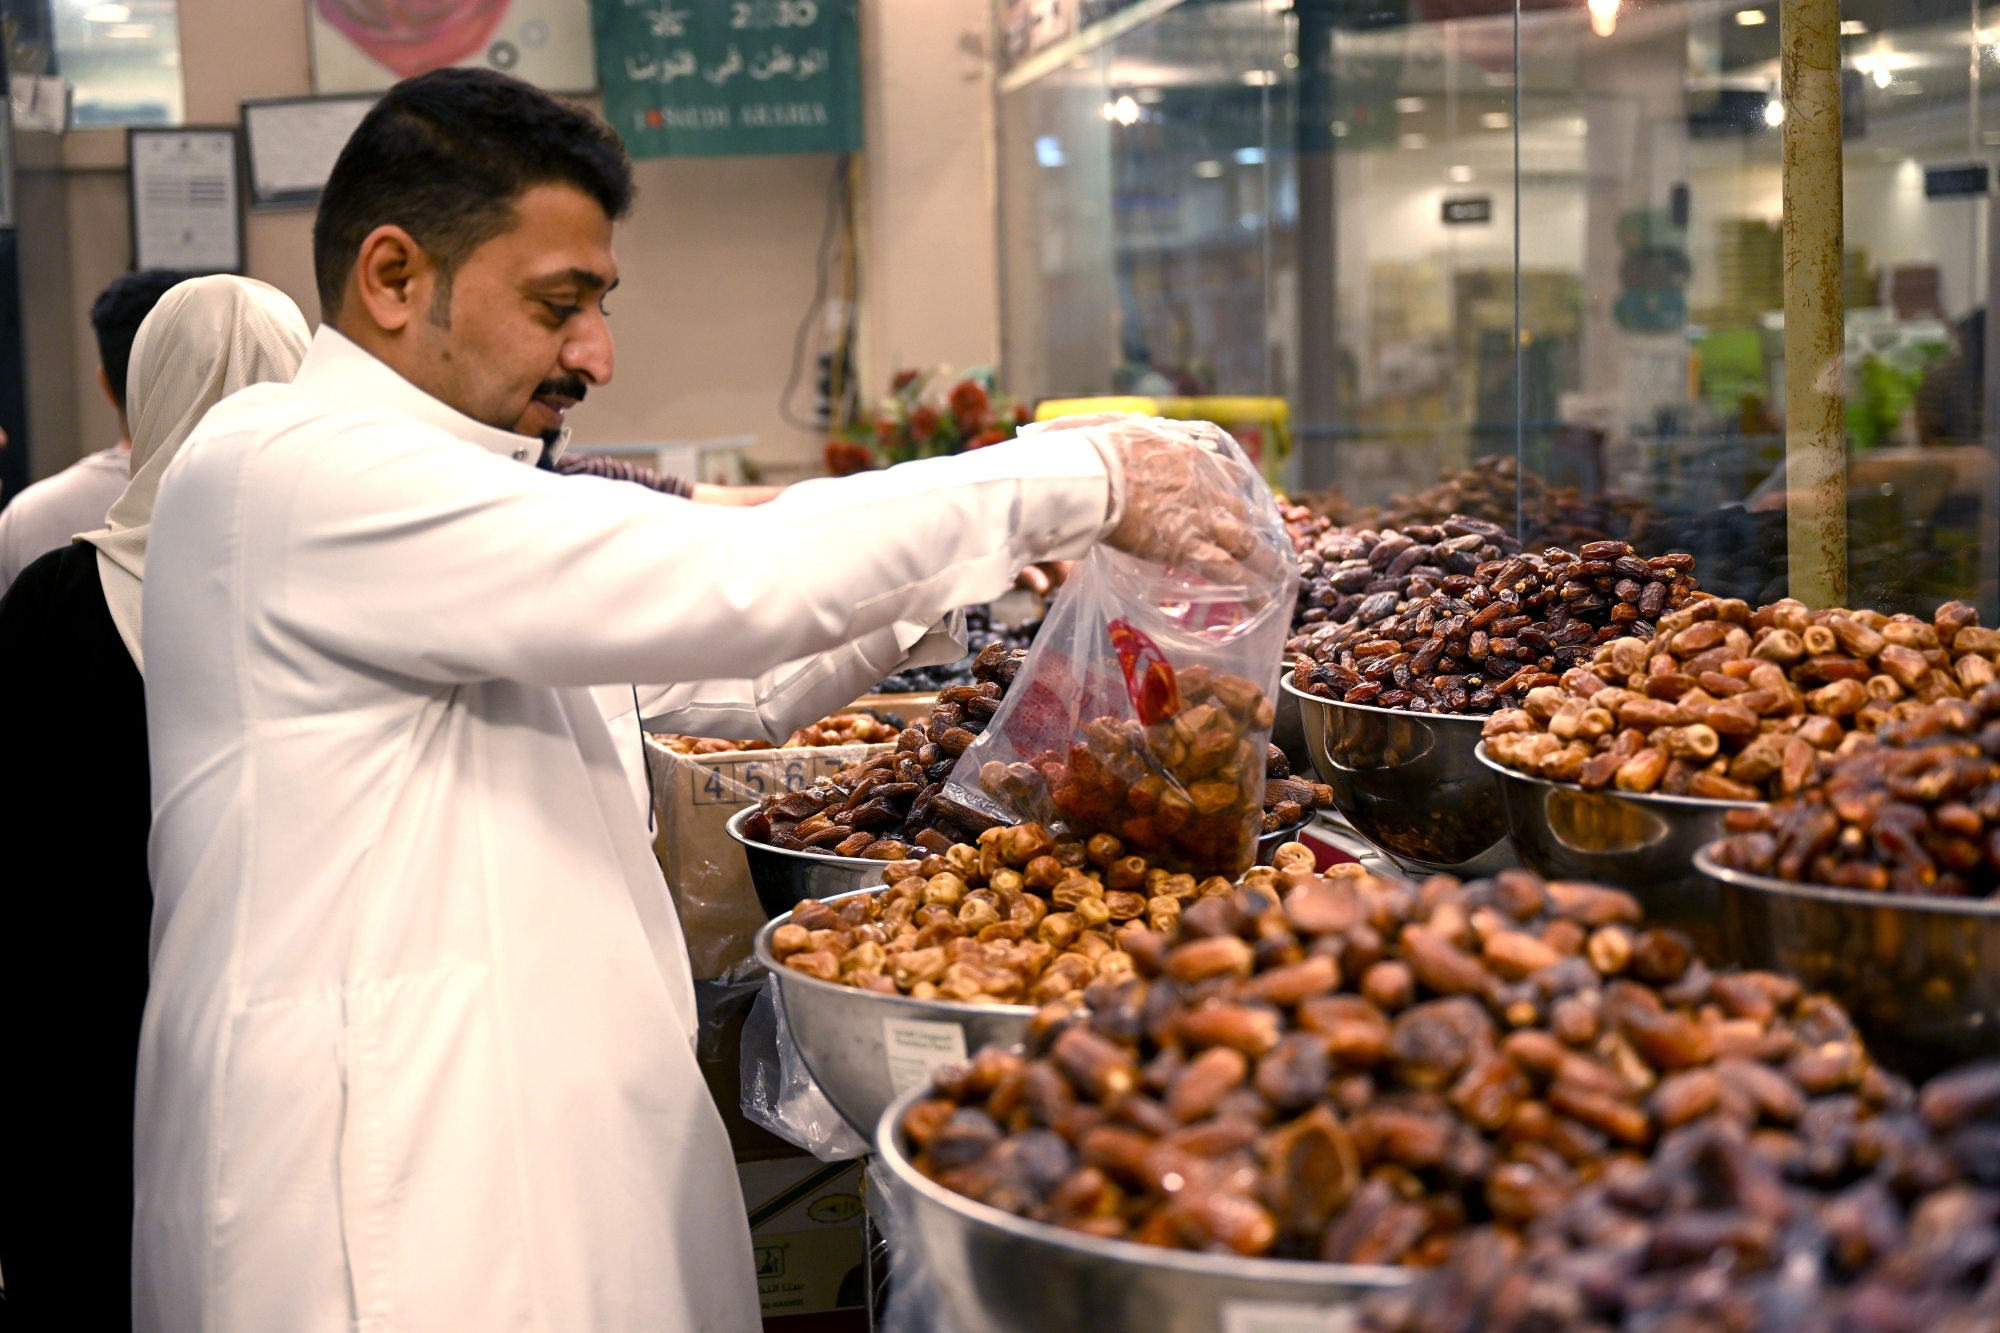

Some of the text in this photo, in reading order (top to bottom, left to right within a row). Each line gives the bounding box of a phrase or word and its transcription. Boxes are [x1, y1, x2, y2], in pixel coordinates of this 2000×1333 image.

[704, 766, 724, 799] 4
[746, 764, 765, 797] 5
[785, 761, 806, 792] 6
